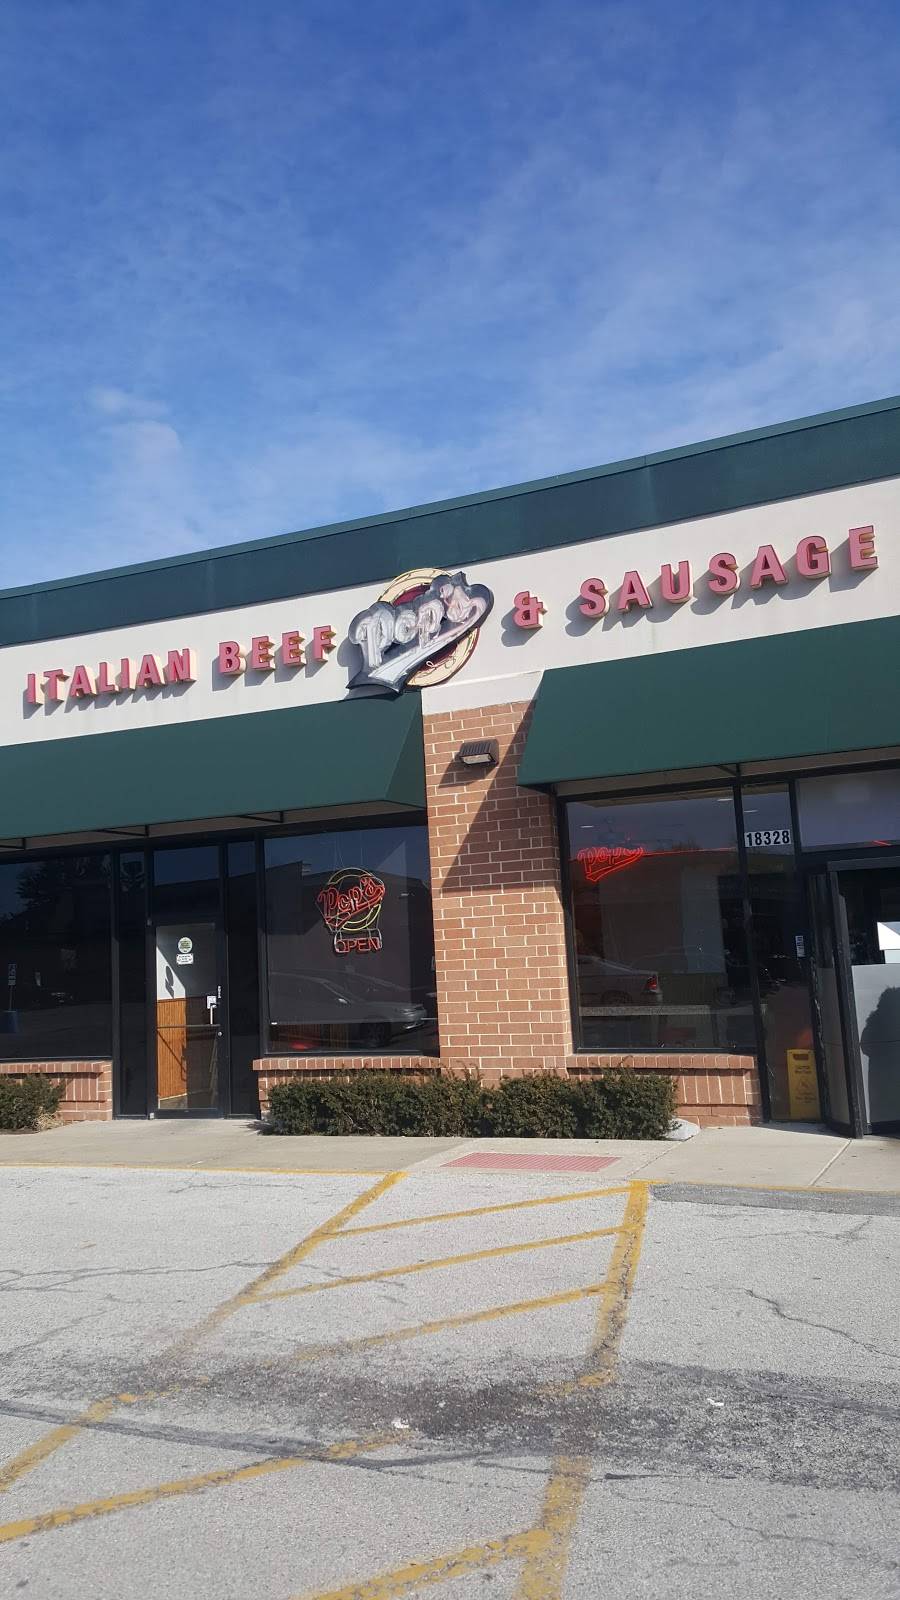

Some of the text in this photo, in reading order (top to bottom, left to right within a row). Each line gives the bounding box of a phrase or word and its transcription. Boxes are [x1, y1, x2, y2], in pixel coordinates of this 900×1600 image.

[26, 524, 879, 705] ITALIAN BEEF & SAUSAGE
[746, 830, 790, 848] 18328
[335, 936, 382, 953] OPEN
